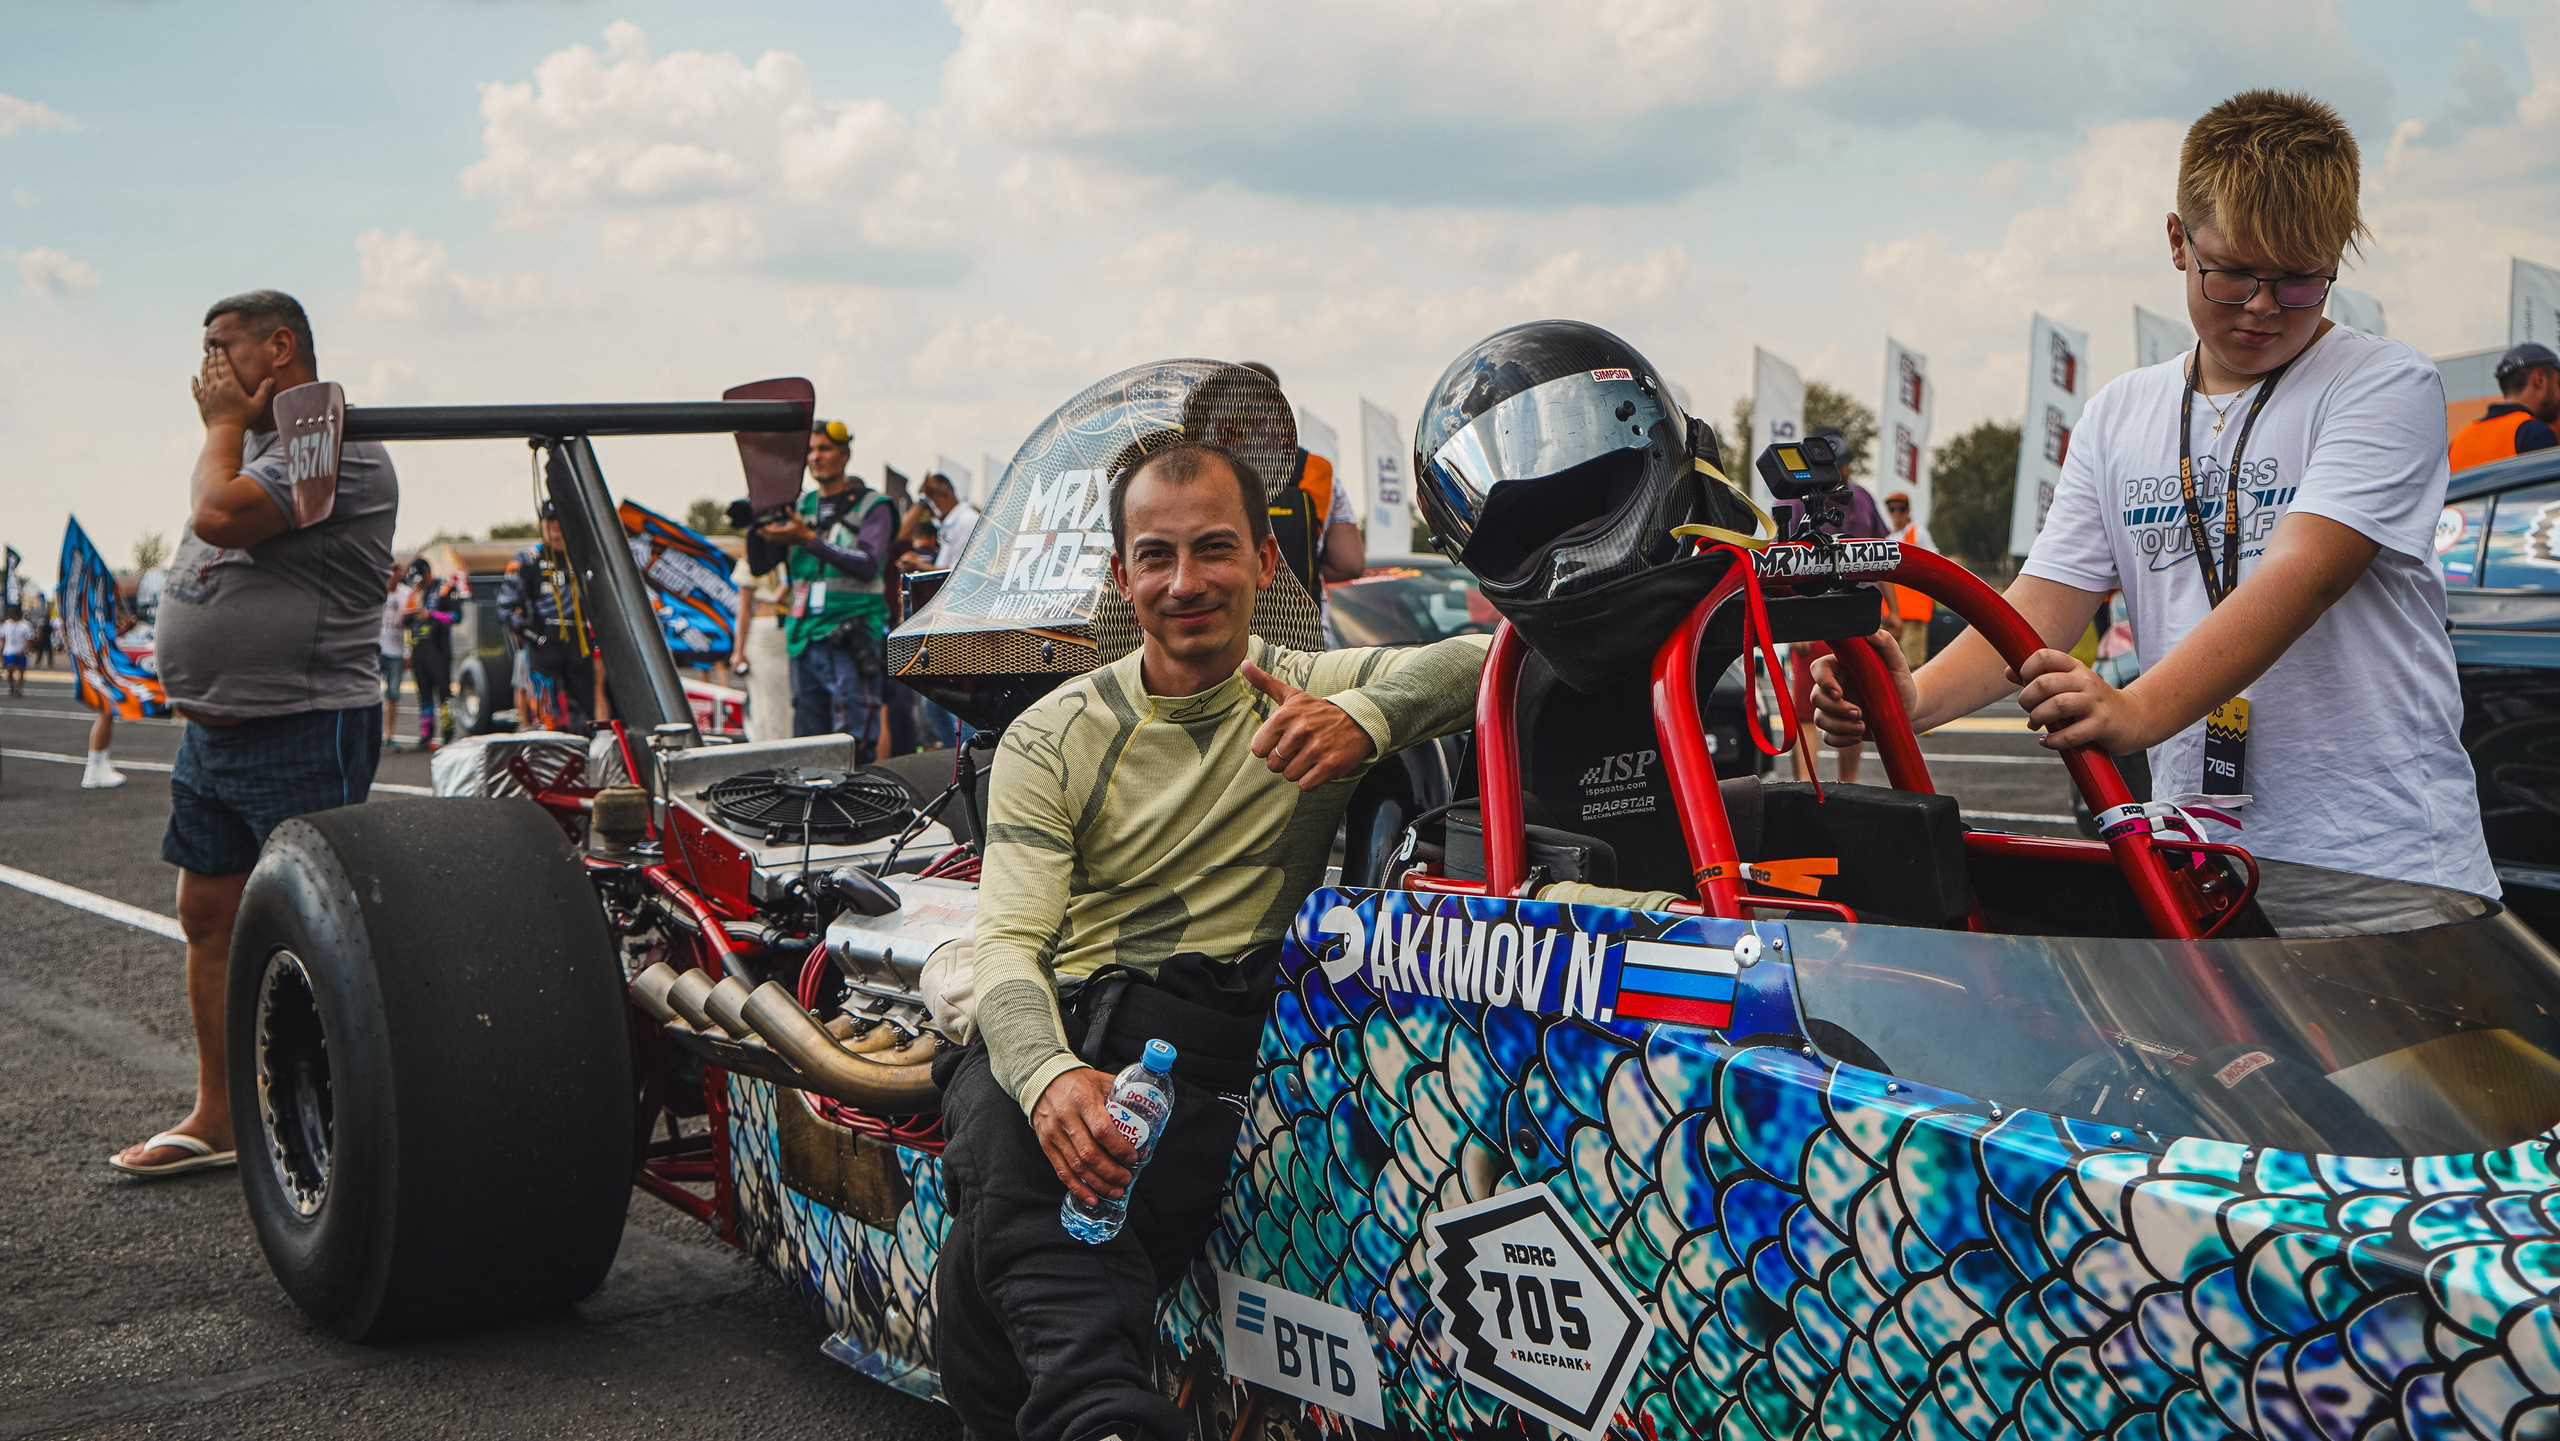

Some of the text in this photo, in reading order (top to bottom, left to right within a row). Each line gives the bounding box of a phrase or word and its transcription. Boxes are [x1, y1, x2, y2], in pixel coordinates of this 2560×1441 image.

[1593, 369, 1631, 381] SIMPSON
[288, 430, 335, 484] 357M
[1378, 455, 1401, 503] ВТБ
[2125, 458, 2279, 507] PROGRSS
[2181, 456, 2195, 500] RDRC
[1018, 468, 1127, 533] MAX
[2225, 489, 2238, 535] RDRC
[2131, 511, 2276, 556] YOUSLF
[2191, 526, 2206, 552] years
[2237, 547, 2266, 561] EMIX
[1801, 561, 1899, 575] MOTRSPORT
[986, 593, 1088, 620] MOTORSPORT
[1600, 749, 1657, 784] ISP
[2206, 756, 2236, 778] 705
[1585, 781, 1647, 796] ispseats.com
[1582, 796, 1655, 815] DRAGSTAR
[2120, 804, 2145, 816] RDR
[2106, 822, 2136, 839] DRC
[1695, 865, 1723, 885] DRC
[1371, 911, 1613, 1023] AKIMOV N.
[2223, 1051, 2267, 1082] SIMPSON
[1501, 1242, 1557, 1268] RDRC
[1480, 1269, 1592, 1351] 705
[1273, 1315, 1356, 1397] ВТБ
[1516, 1349, 1585, 1371] RACEPARK
